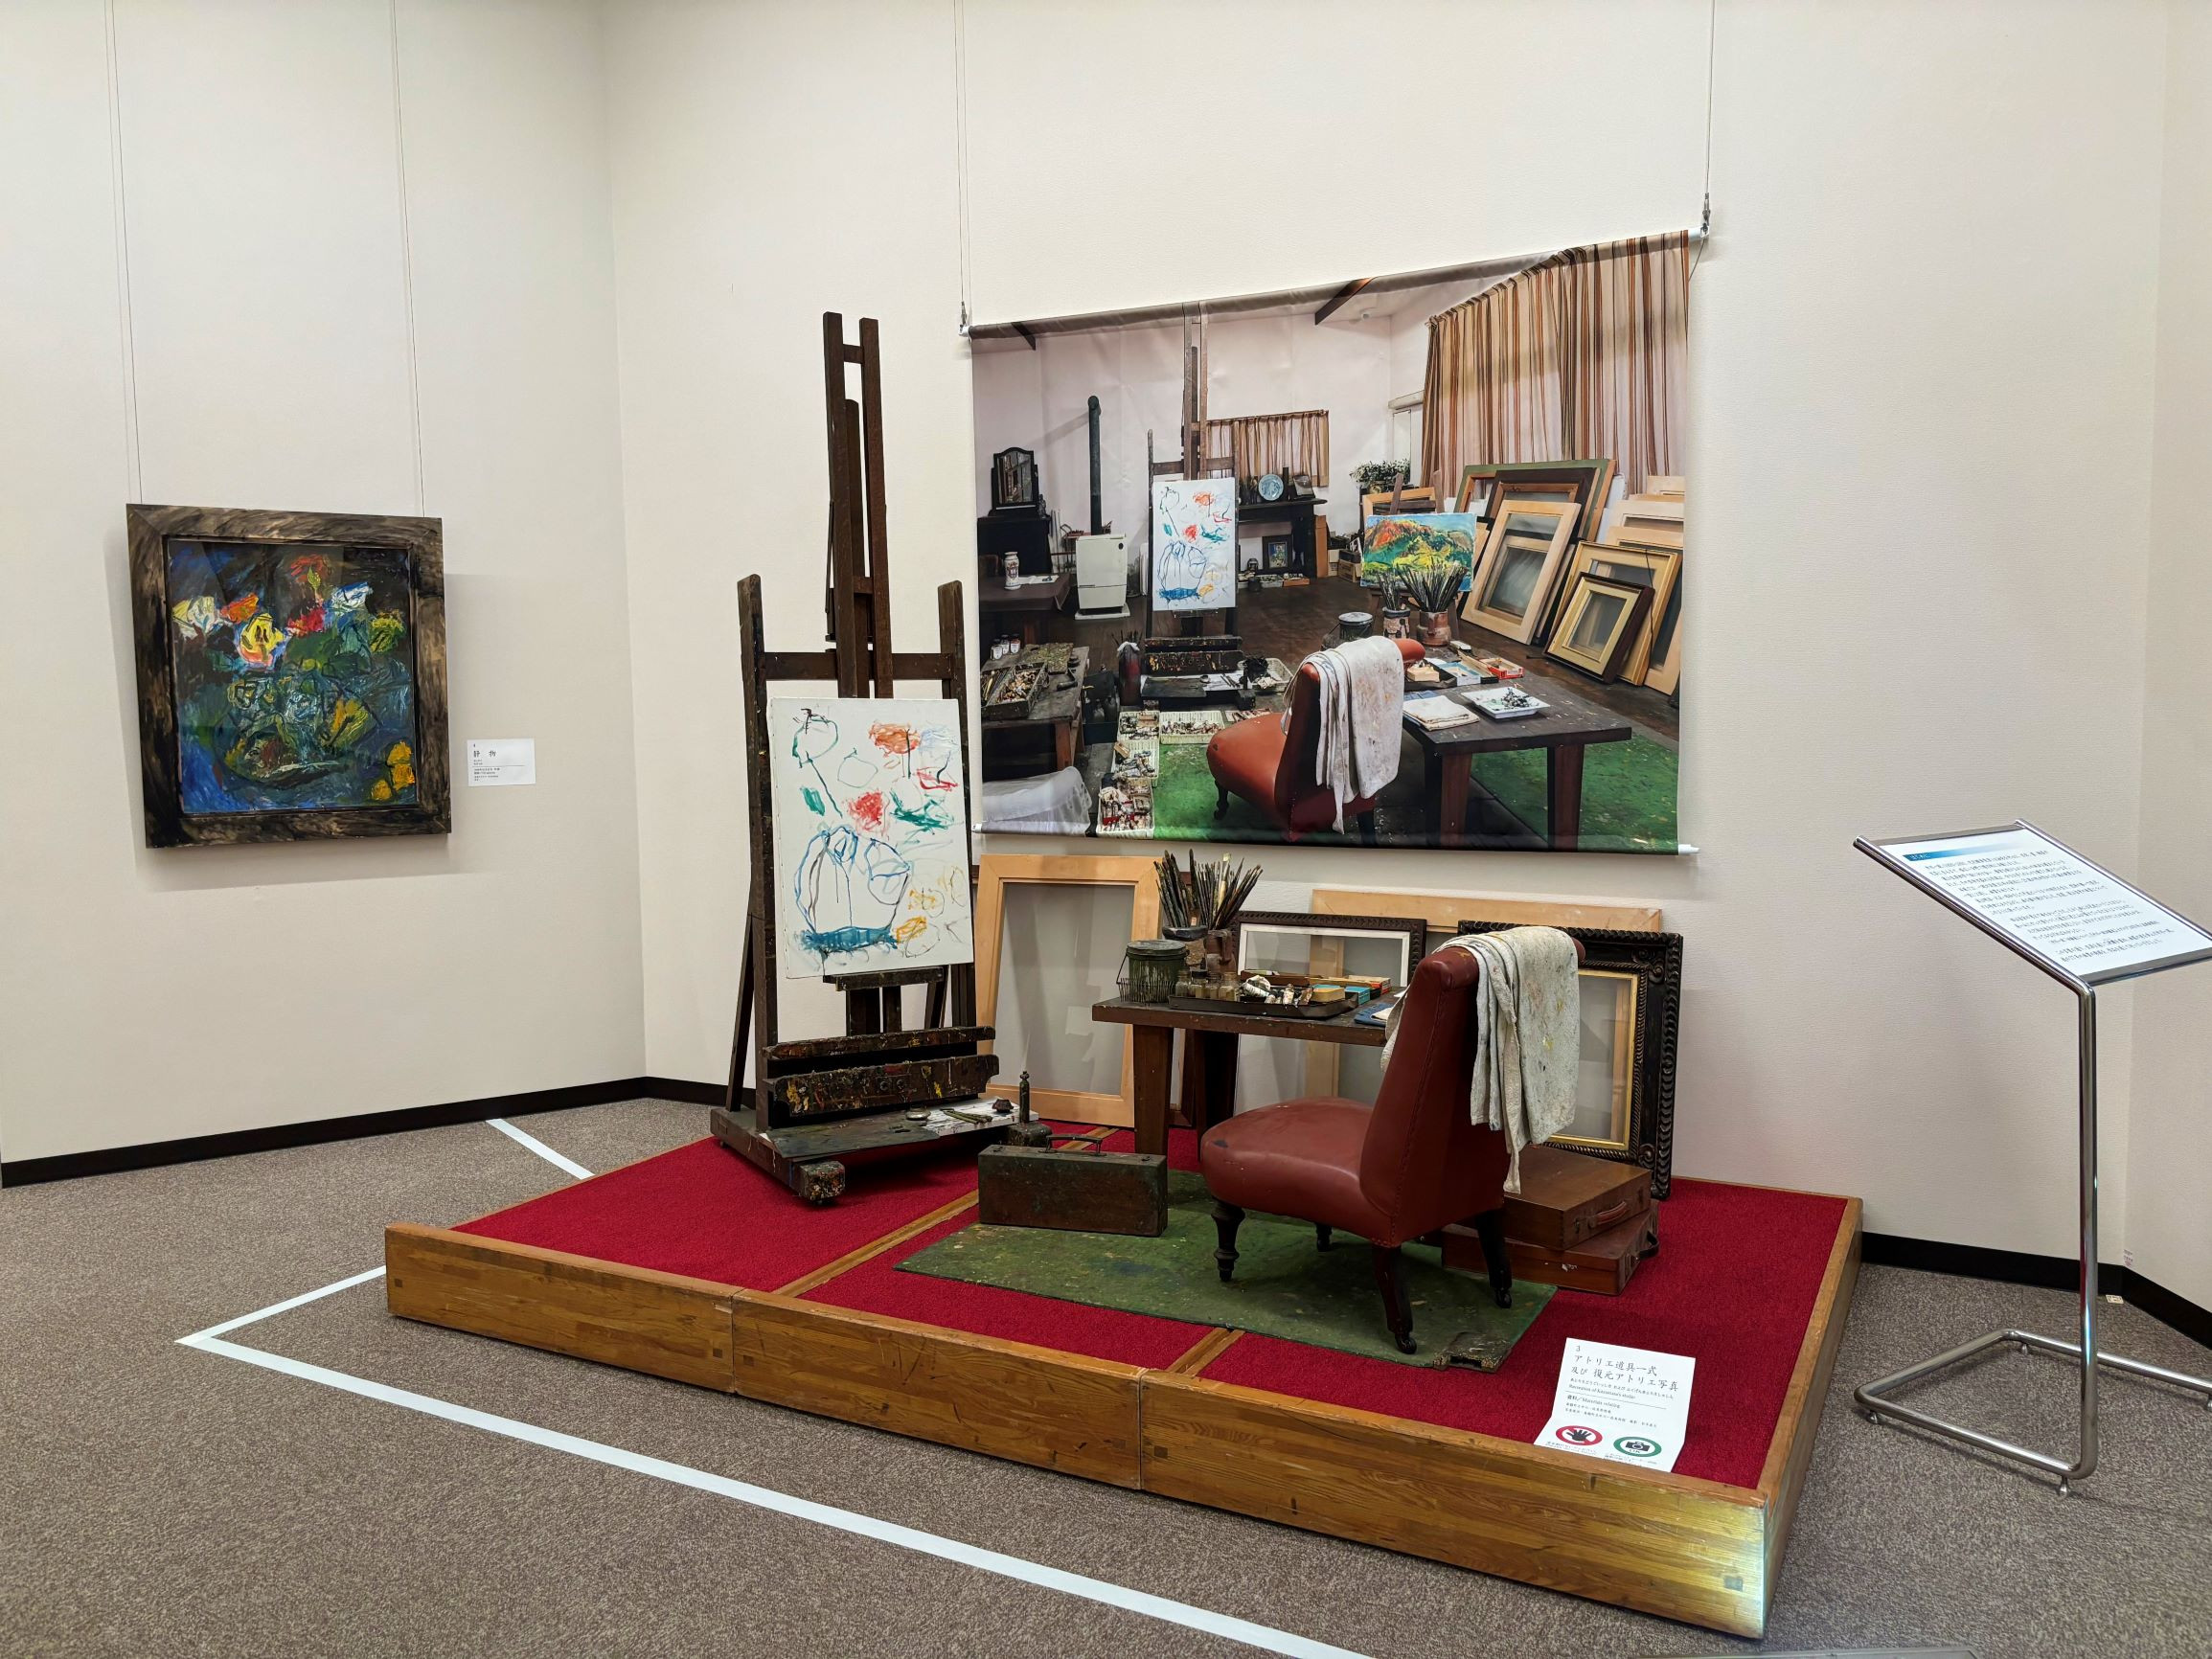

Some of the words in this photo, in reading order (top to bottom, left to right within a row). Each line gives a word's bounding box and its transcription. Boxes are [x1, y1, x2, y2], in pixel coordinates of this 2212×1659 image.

[1574, 1354, 1657, 1376] アトリエ道具一式
[1571, 1366, 1588, 1375] 及び
[1593, 1368, 1678, 1392] 復元アトリエ写真
